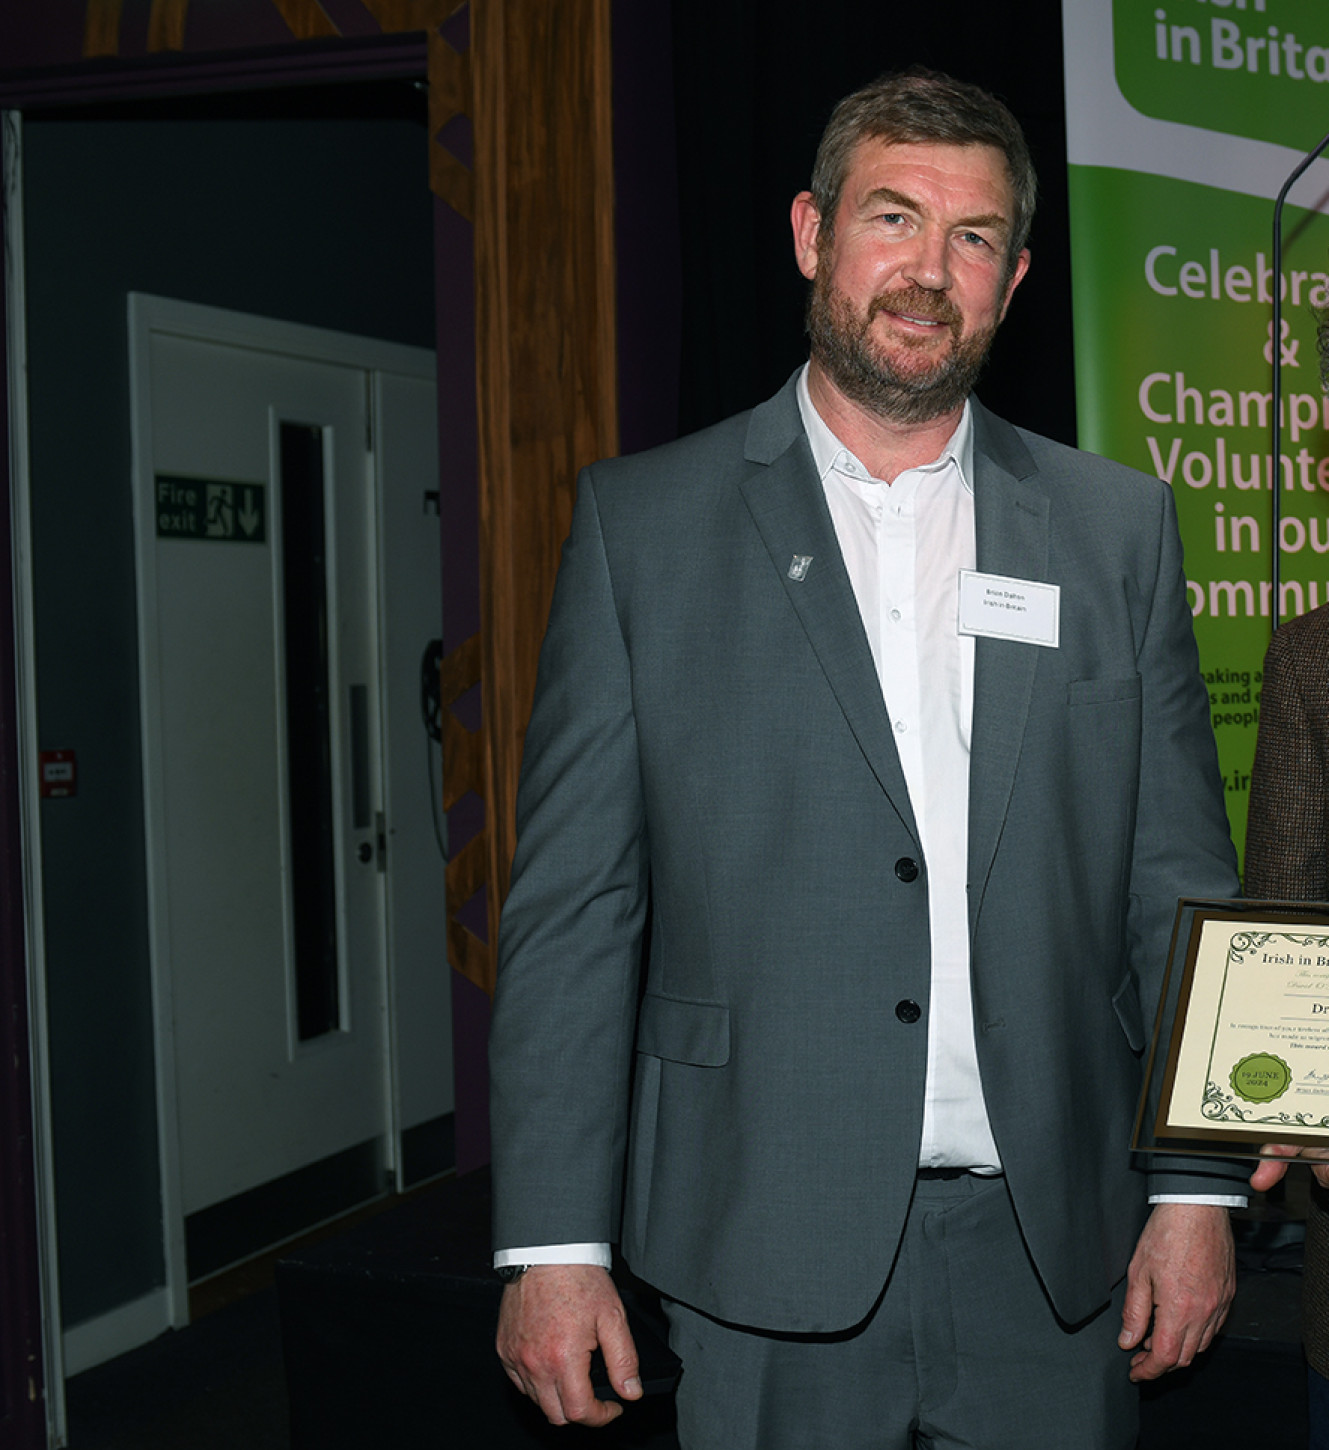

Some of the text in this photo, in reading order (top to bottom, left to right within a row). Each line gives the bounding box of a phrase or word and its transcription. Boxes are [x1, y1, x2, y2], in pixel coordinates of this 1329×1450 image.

[1154, 8, 1201, 65] in
[1263, 318, 1300, 368] &
[158, 482, 197, 506] Fire
[159, 509, 197, 532] exit
[1214, 502, 1260, 553] in
[1221, 688, 1251, 705] and
[1262, 953, 1294, 965] Irish
[1298, 954, 1312, 966] in
[1312, 1003, 1329, 1015] Dr
[1245, 1080, 1269, 1088] 2024
[1252, 1071, 1279, 1080] JUNE
